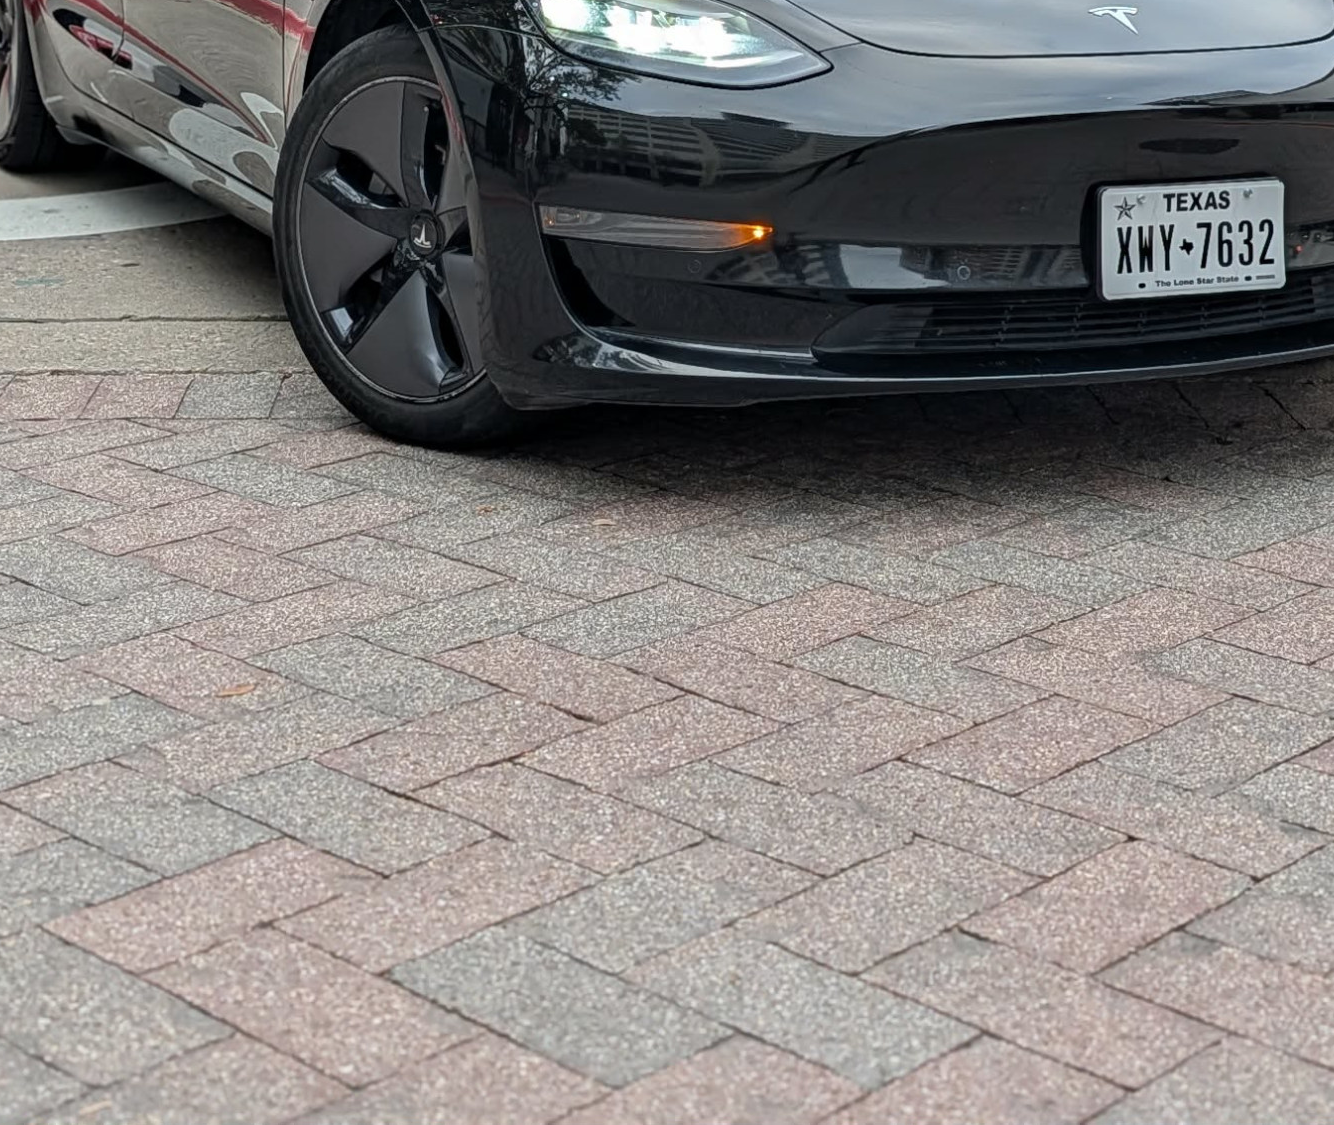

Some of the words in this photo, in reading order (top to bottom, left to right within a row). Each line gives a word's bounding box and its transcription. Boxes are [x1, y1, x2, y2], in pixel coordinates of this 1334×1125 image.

[1163, 190, 1231, 213] TEXAS
[1117, 224, 1175, 275] XWY
[1196, 219, 1275, 270] 7632
[1155, 280, 1171, 288] The
[1173, 278, 1194, 287] Lone
[1196, 277, 1214, 285] Star
